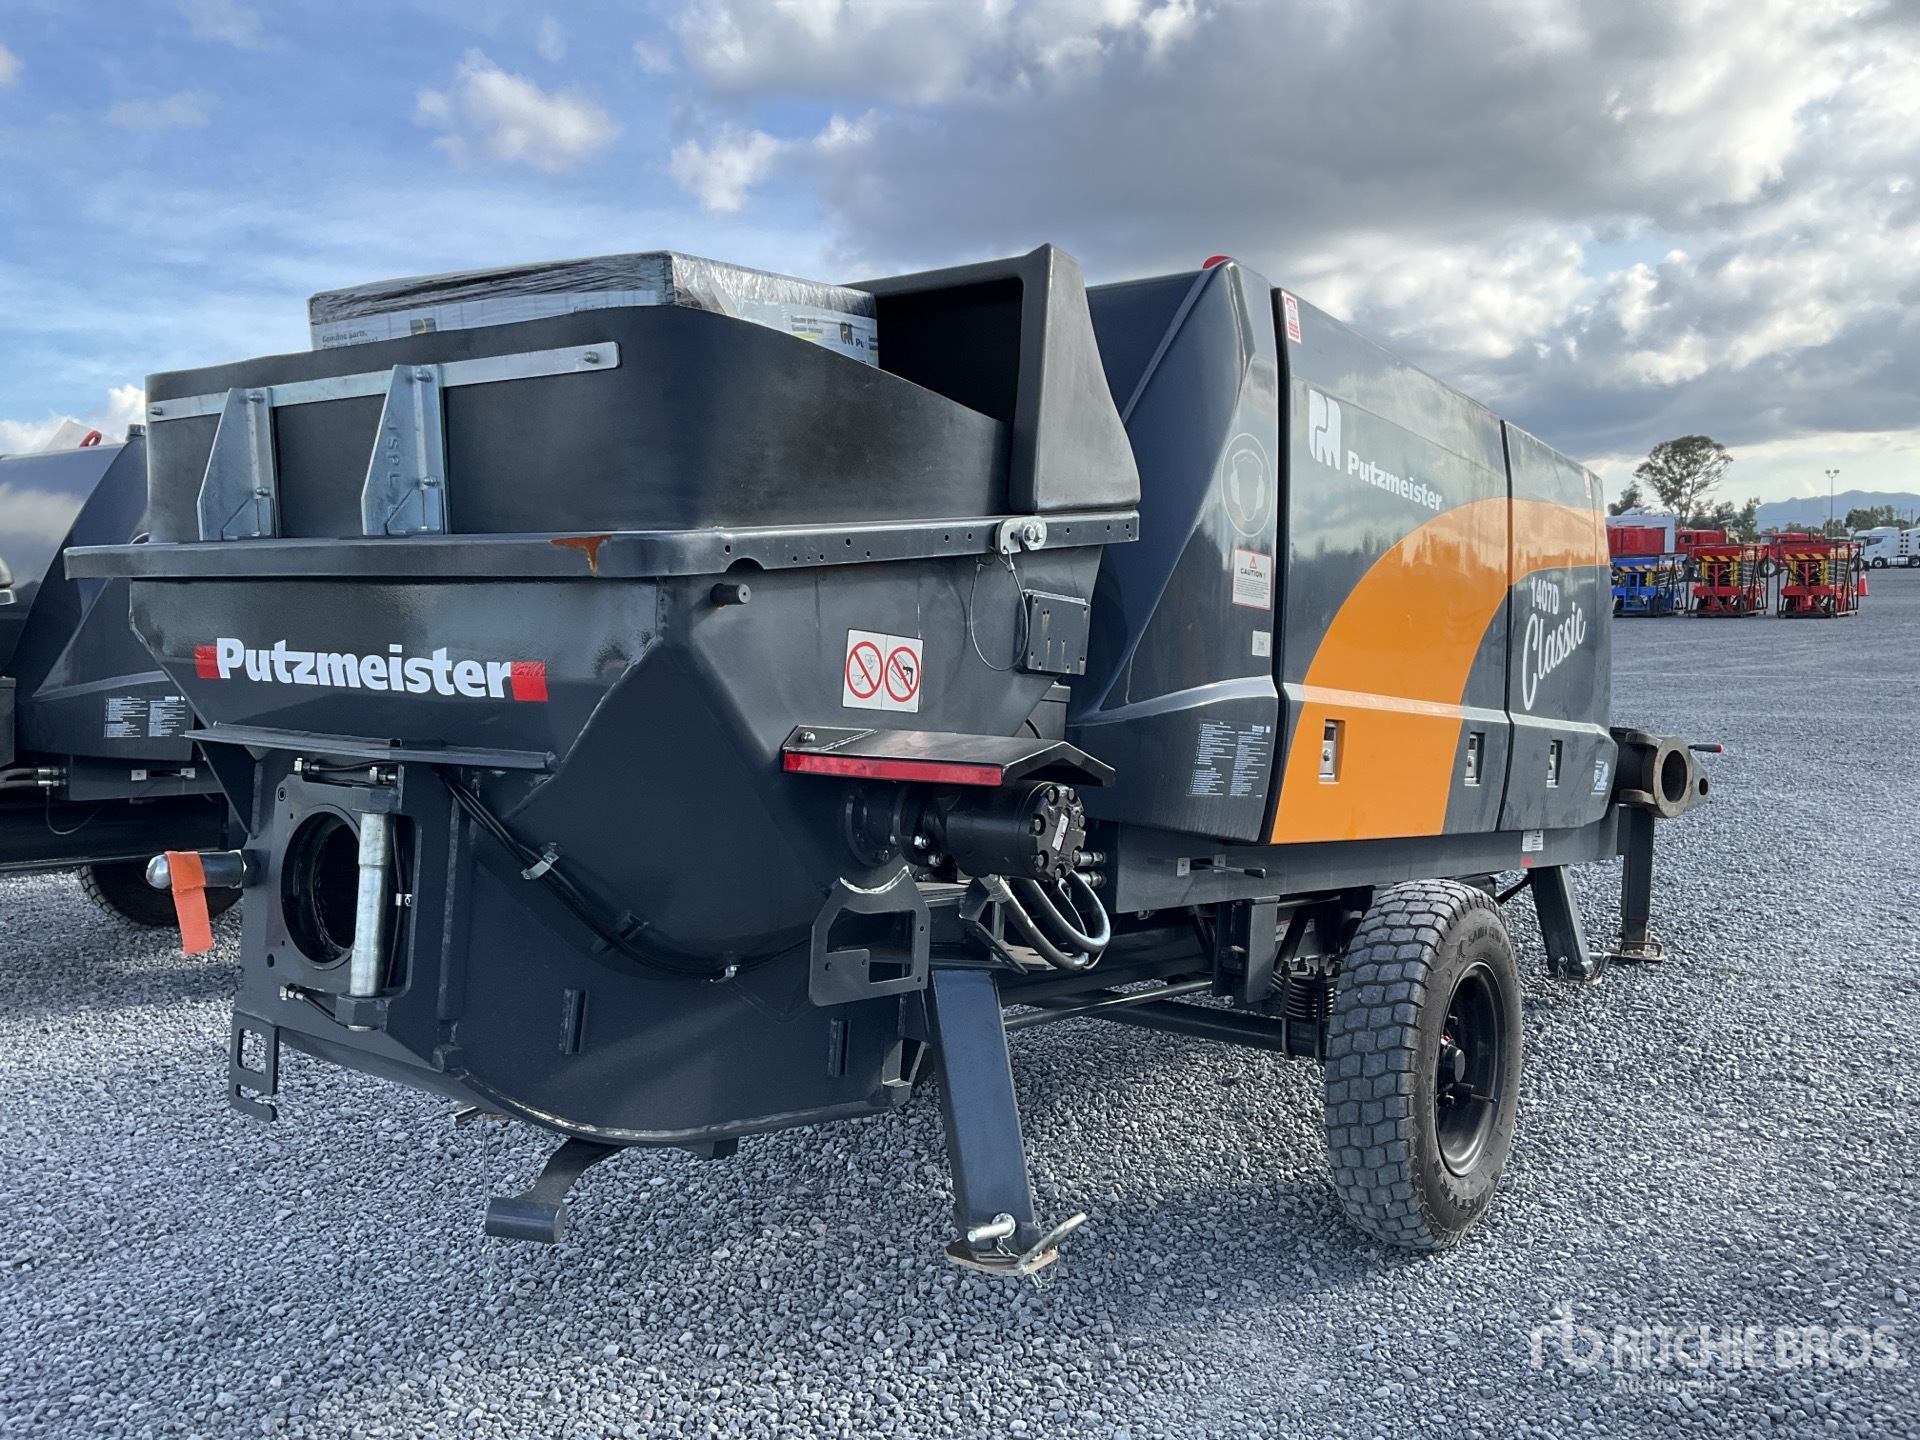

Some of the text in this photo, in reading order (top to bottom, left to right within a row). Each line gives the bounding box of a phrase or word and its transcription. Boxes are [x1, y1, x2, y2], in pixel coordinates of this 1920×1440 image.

[1347, 449, 1442, 511] Putzmeister
[1240, 567, 1263, 578] CAUTION
[1531, 576, 1559, 615] 1407D
[216, 637, 511, 698] Putzmeister
[1522, 601, 1586, 711] Classic
